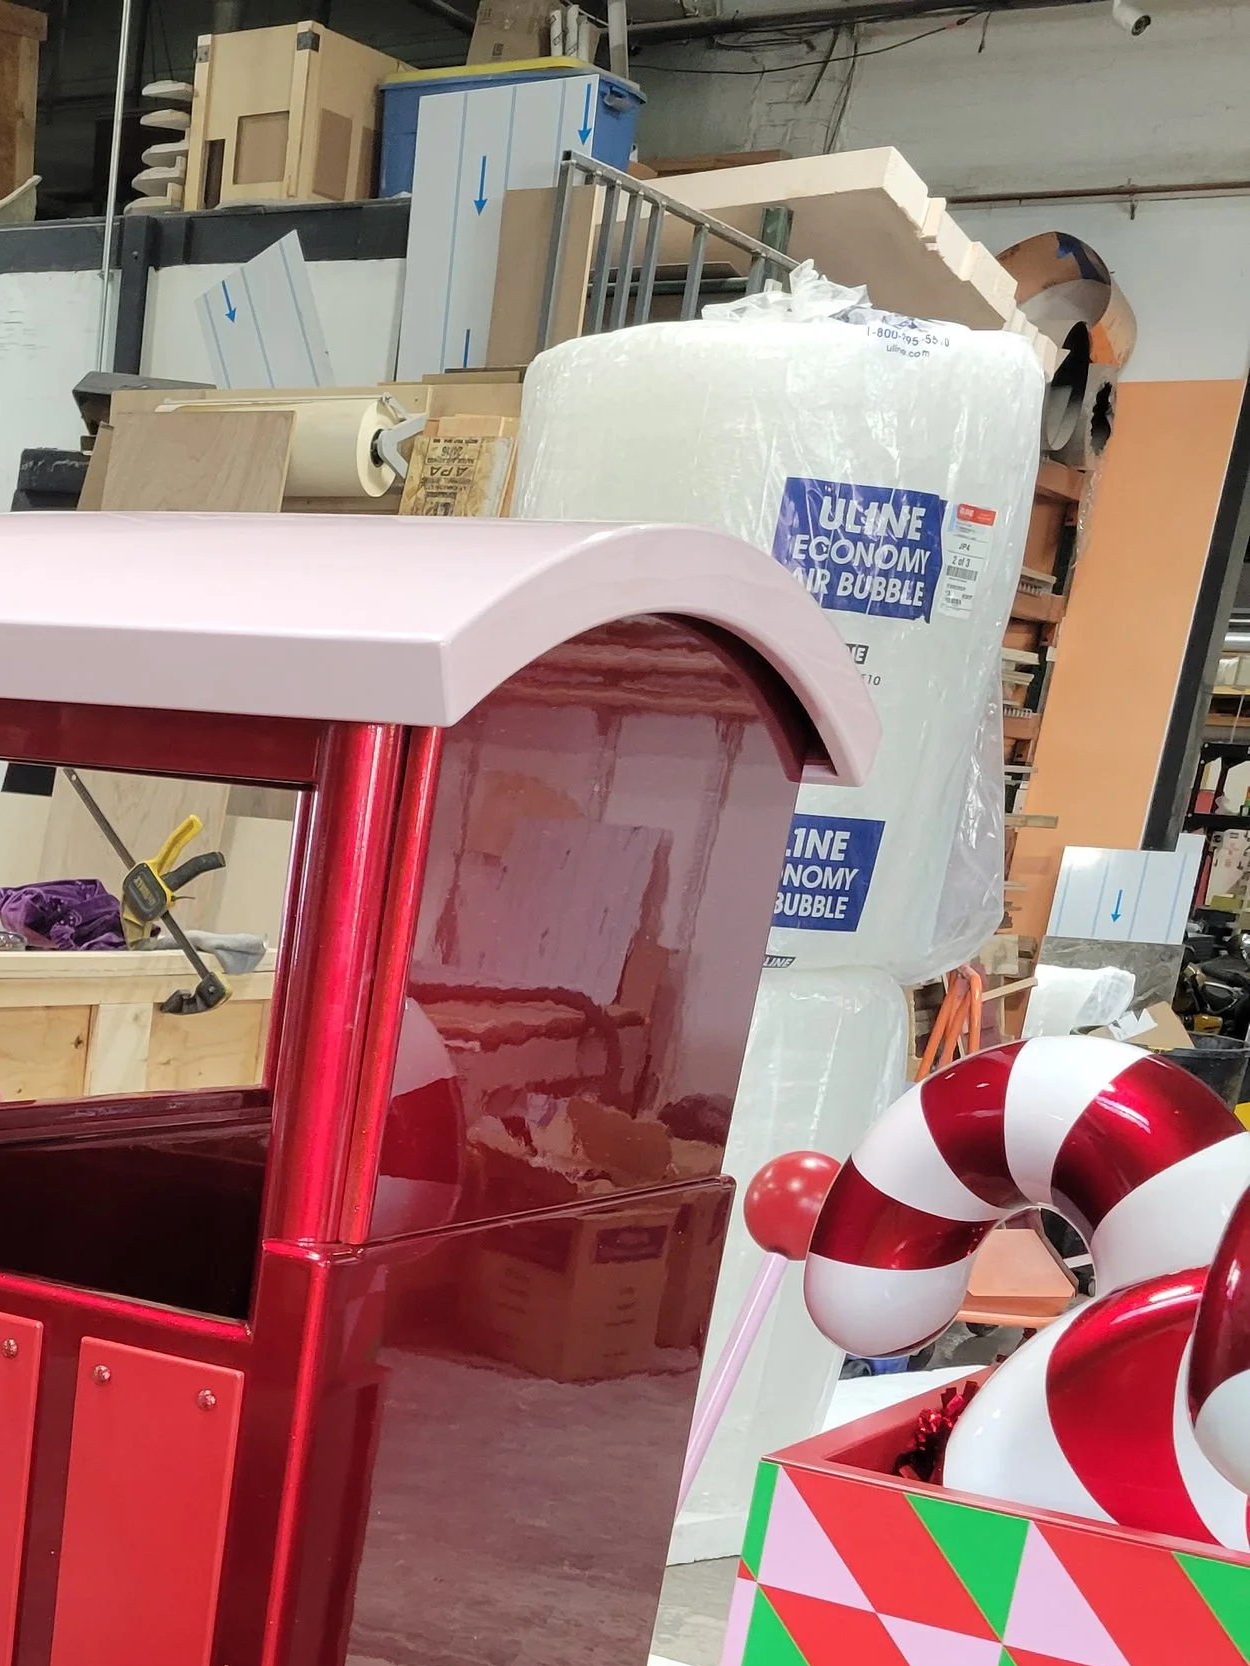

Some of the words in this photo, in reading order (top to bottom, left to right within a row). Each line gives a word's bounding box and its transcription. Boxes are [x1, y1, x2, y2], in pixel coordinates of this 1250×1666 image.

[430, 466, 468, 477] APA
[819, 496, 926, 541] ULINE
[792, 534, 931, 575] ECONOMY
[952, 555, 957, 565] 2
[957, 557, 966, 567] of
[965, 559, 971, 568] 3
[836, 571, 925, 607] BUBBLE
[785, 827, 851, 861] INE
[781, 863, 859, 891] NOMY
